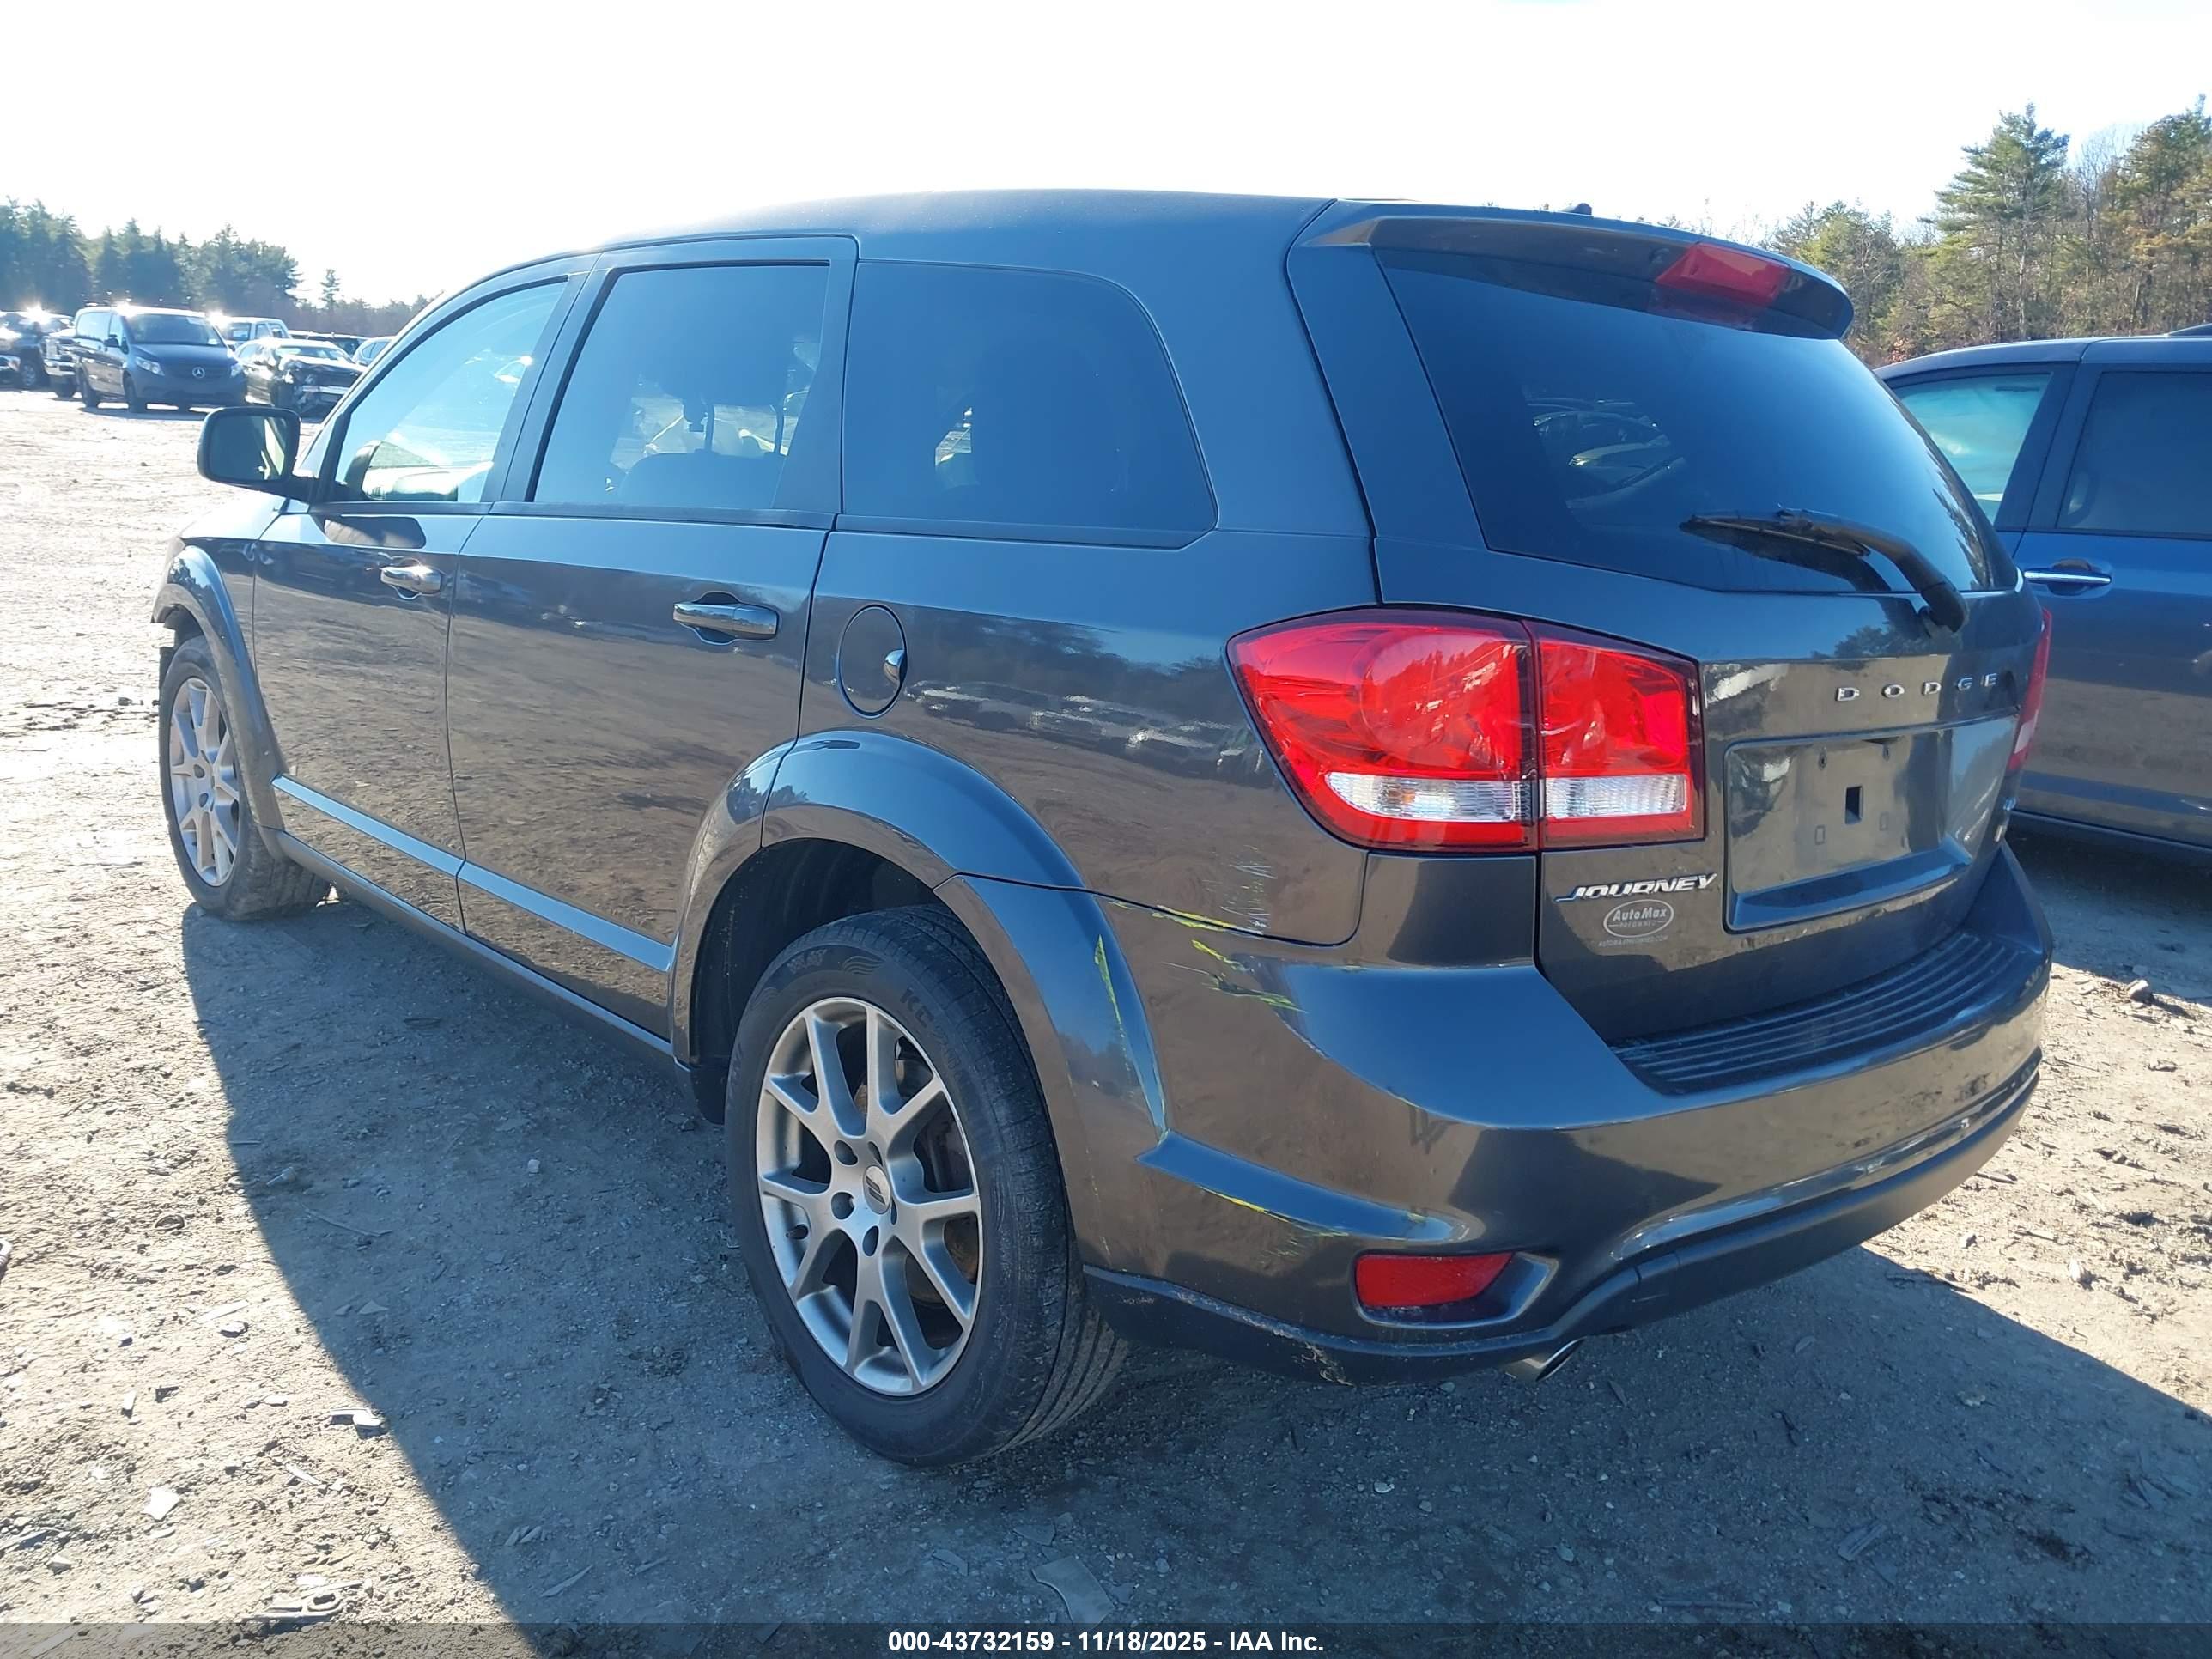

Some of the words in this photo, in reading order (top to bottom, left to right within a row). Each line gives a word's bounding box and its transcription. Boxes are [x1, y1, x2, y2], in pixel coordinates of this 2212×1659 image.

[1835, 672, 1998, 702] DODGE
[1554, 872, 1717, 902] JOURNEY
[1612, 907, 1668, 921] AutoMax
